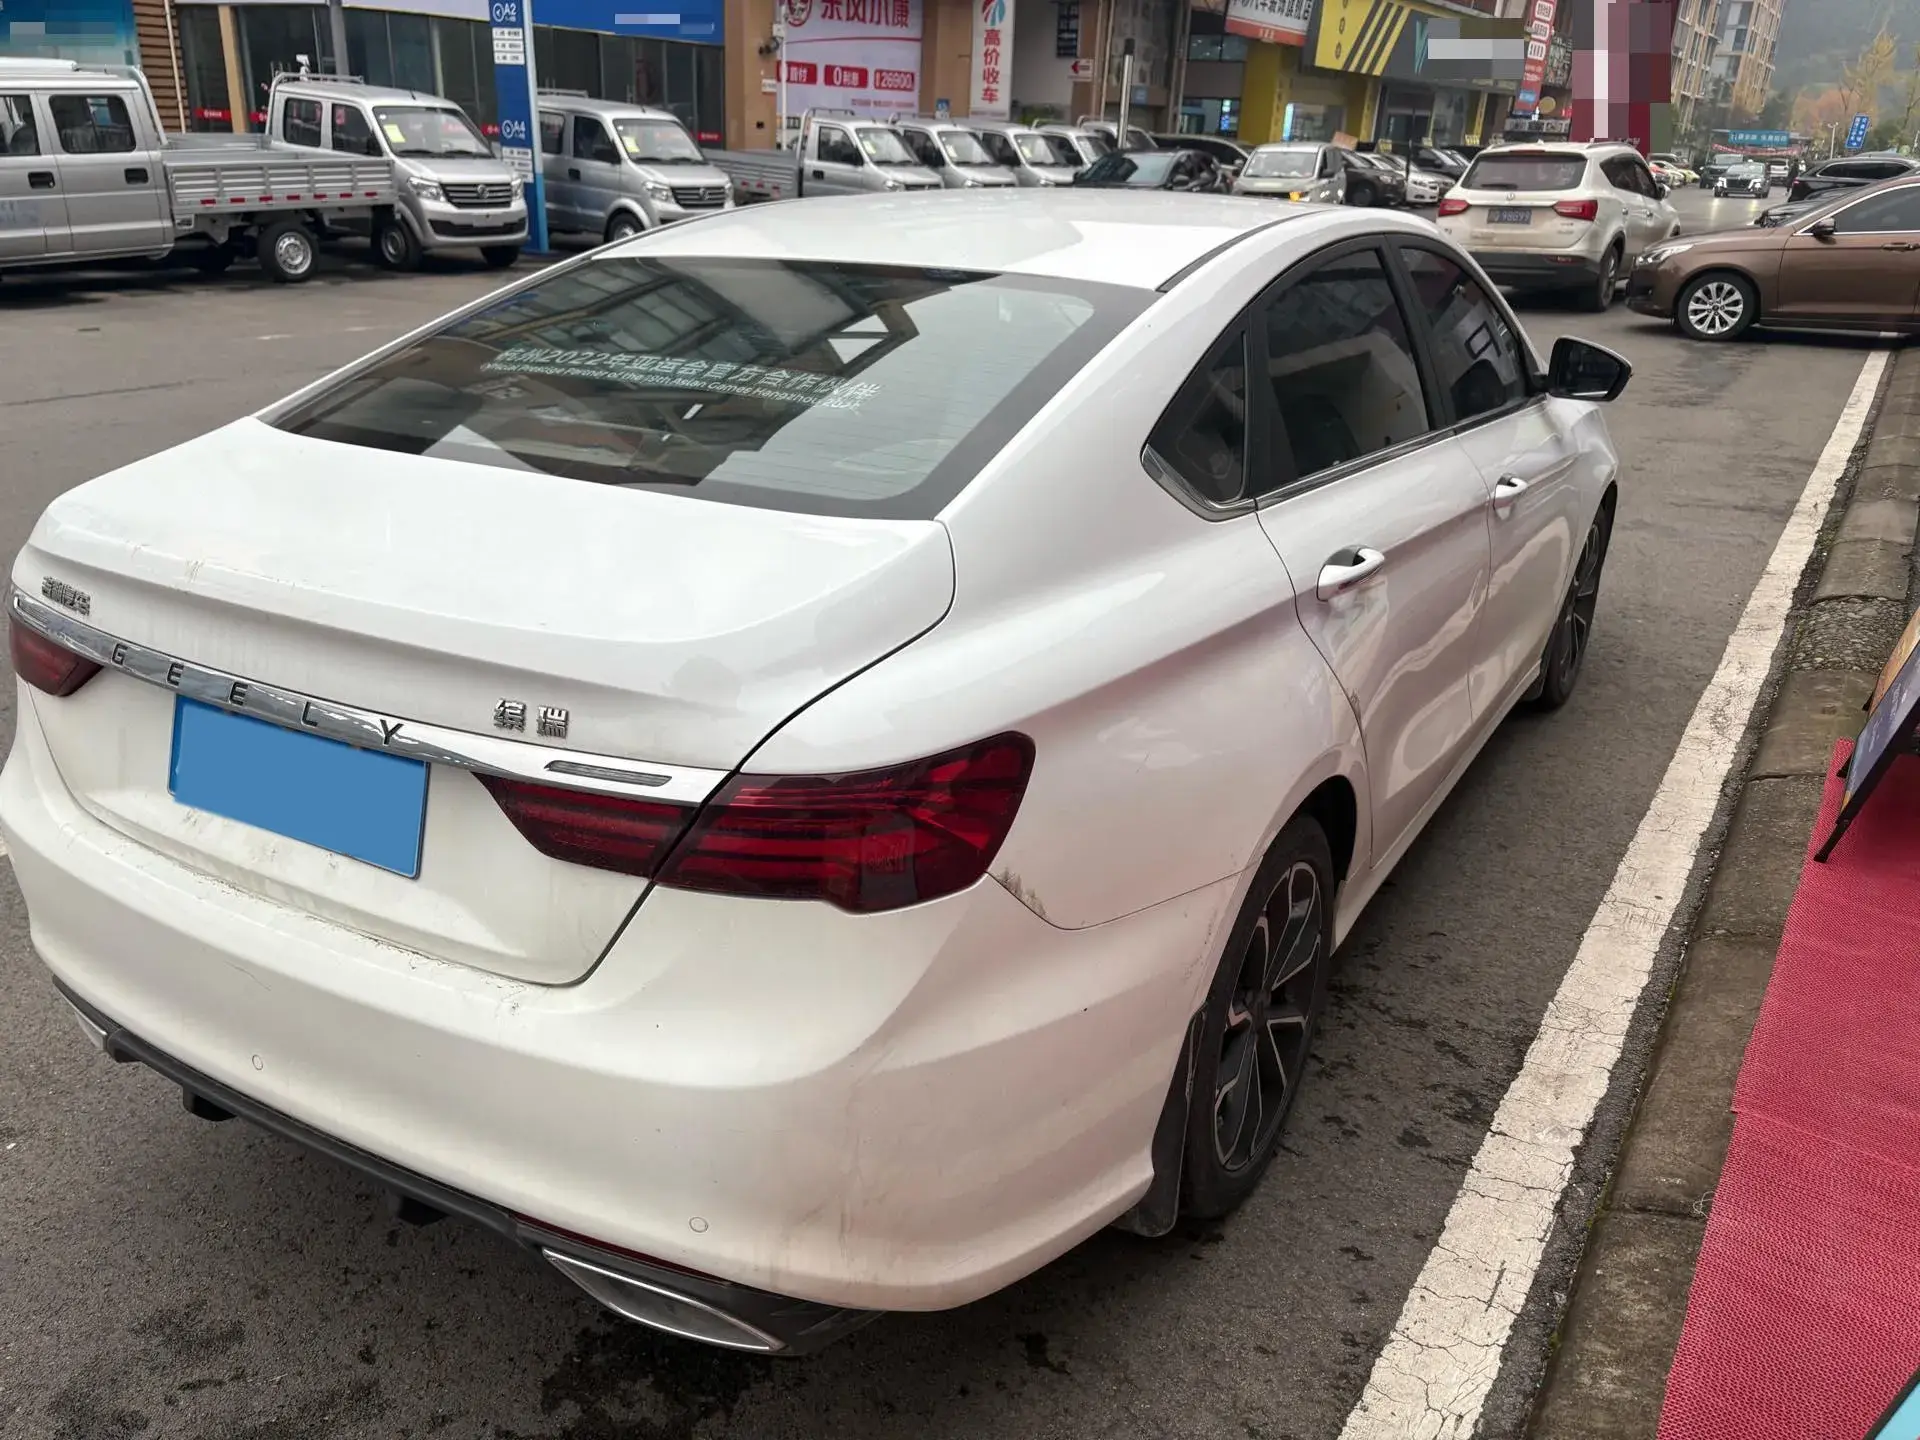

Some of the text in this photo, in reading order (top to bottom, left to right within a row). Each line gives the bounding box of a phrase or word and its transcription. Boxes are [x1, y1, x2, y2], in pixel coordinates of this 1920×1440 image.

[981, 29, 1001, 104] 高价收车
[562, 366, 606, 379] Partner
[621, 371, 644, 383] the
[672, 377, 706, 389] Asian
[706, 381, 751, 394] Games
[111, 642, 404, 746] GEELY
